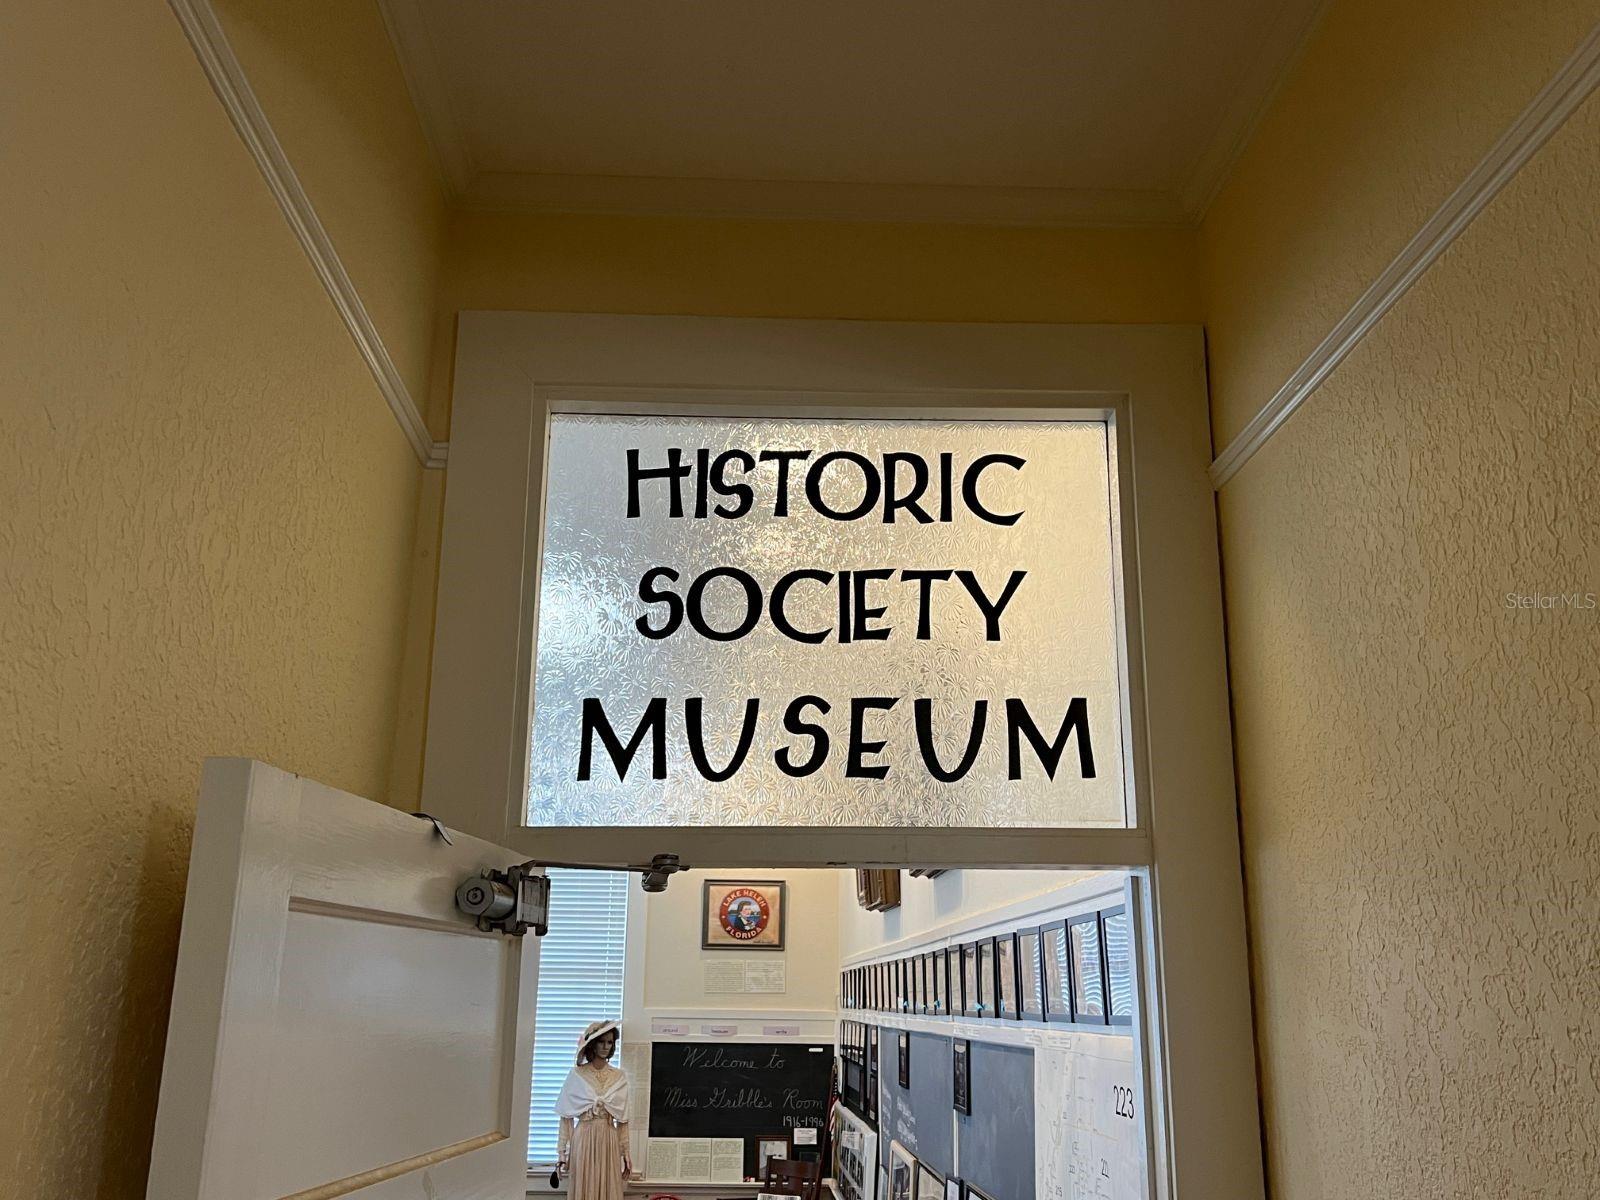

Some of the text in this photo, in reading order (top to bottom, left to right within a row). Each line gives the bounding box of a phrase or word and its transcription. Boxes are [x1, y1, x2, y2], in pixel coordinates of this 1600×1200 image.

[626, 448, 1027, 526] HISTORIC
[635, 566, 1028, 644] SOCIETY
[577, 695, 1097, 783] MUSEUM
[723, 889, 767, 907] LAKE HELEN
[725, 926, 762, 939] FLORIDA
[682, 1046, 787, 1069] Welcome to
[664, 1087, 699, 1109] Miss
[782, 1088, 824, 1110] Room
[1114, 1085, 1135, 1119] 223
[783, 1115, 824, 1128] 1916-1996
